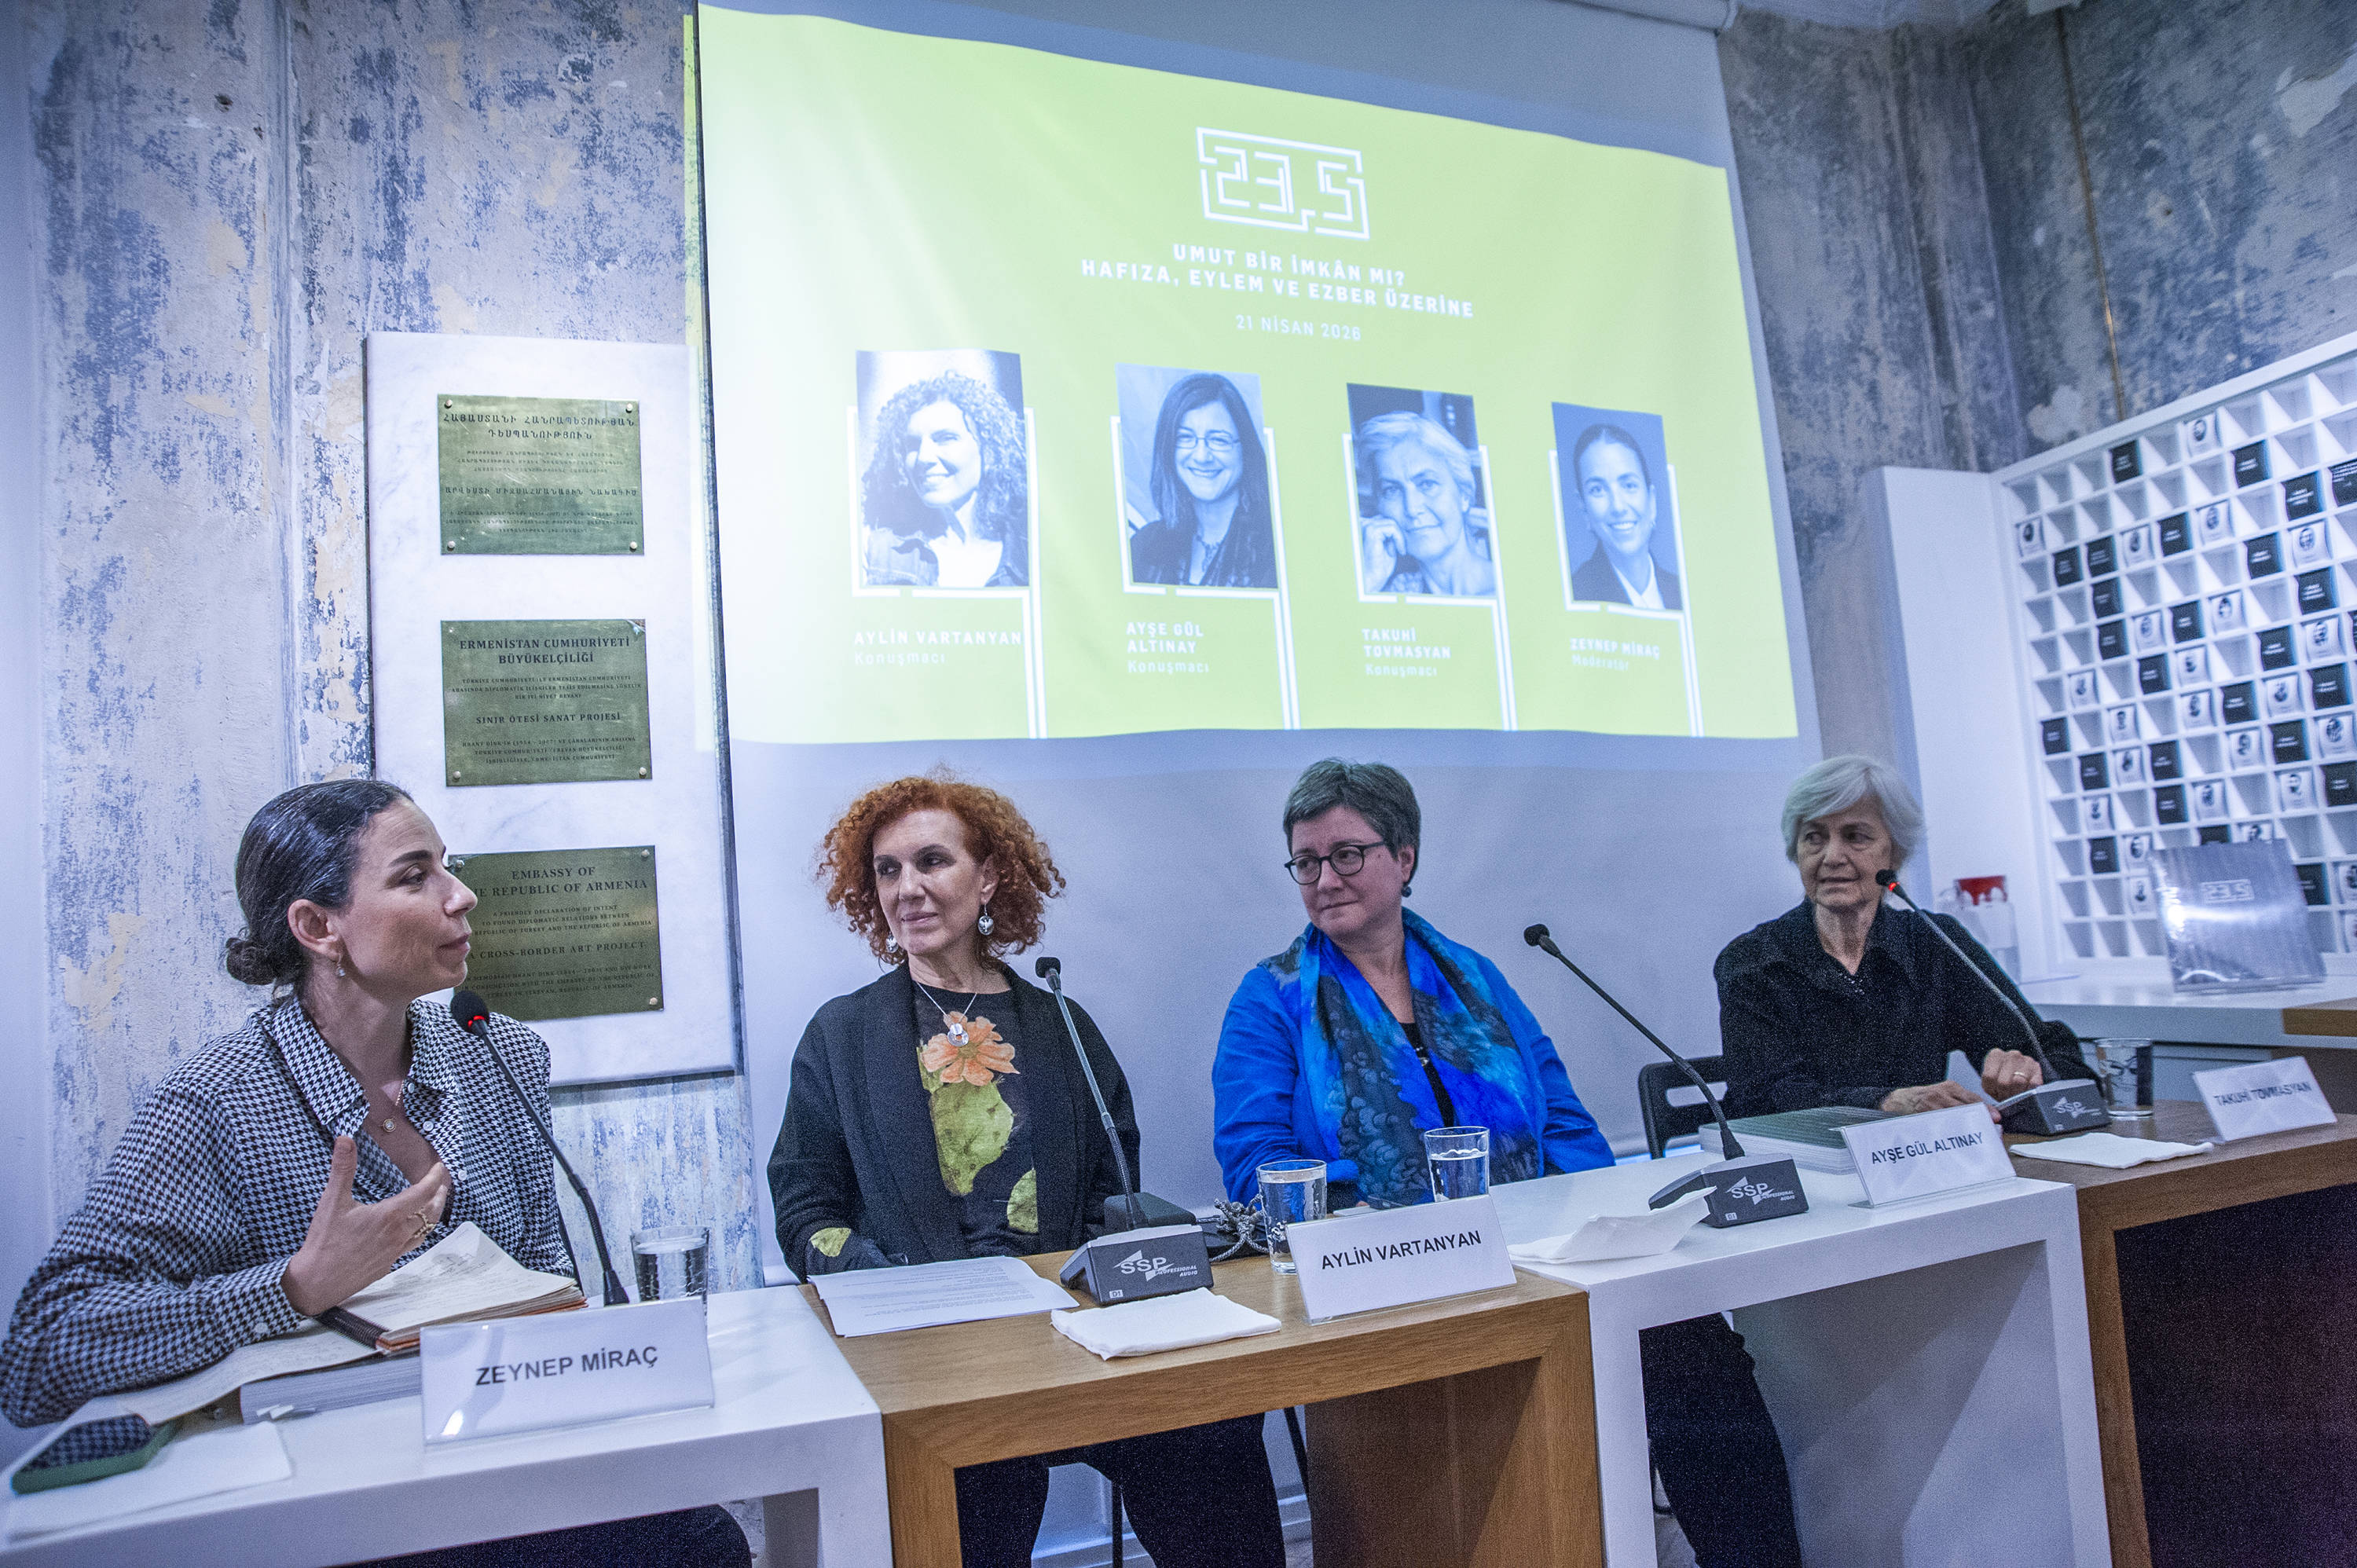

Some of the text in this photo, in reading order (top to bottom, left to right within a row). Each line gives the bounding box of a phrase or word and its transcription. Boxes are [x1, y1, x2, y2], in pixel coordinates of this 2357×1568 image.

[1173, 244, 1405, 288] UMUT BİR İMKÂN MI?
[1081, 258, 1474, 318] HAFIZA, EYLEM VE EZBER ÜZERİNE
[1236, 314, 1362, 341] 21 NİSAN 2026
[444, 413, 516, 423] ՀԱՅԱՍՏԱՆԻ
[854, 628, 1021, 645] AYLİN VARTANYAN
[1126, 621, 1204, 639] AYŞE GÜL
[460, 636, 630, 650] ERMENİSTAN CUMHURİYETİ
[1127, 639, 1197, 654] ALTINAY
[1363, 644, 1451, 659] TOVMASYAN
[1570, 637, 1660, 661] ZEYNEP MİRAÇ
[498, 651, 594, 665] BÜYÜKELÇİLİĞİ
[855, 651, 945, 666] Konuşmacı
[1127, 660, 1209, 676] Konuşmacı
[1365, 663, 1438, 678] Konuşmacı
[476, 712, 621, 724] SINIR ÖTESİ SANAT PROJESİ
[511, 866, 596, 881] EMBASSY OF
[493, 884, 559, 896] REPUBLIC
[564, 882, 581, 893] OF
[588, 879, 648, 892] ARMENIA
[480, 946, 566, 959] CROSS-BORDER
[570, 943, 592, 953] ART
[597, 941, 645, 951] PROJECT
[1871, 1131, 1983, 1164] AYŞE GÜL ALTINAY
[1731, 1182, 1769, 1199] SSP
[1321, 1229, 1482, 1270] AYLİN VARTANYAN
[1120, 1257, 1167, 1275] SSP
[475, 1346, 658, 1387] ZEYNEP MİRAÇ
